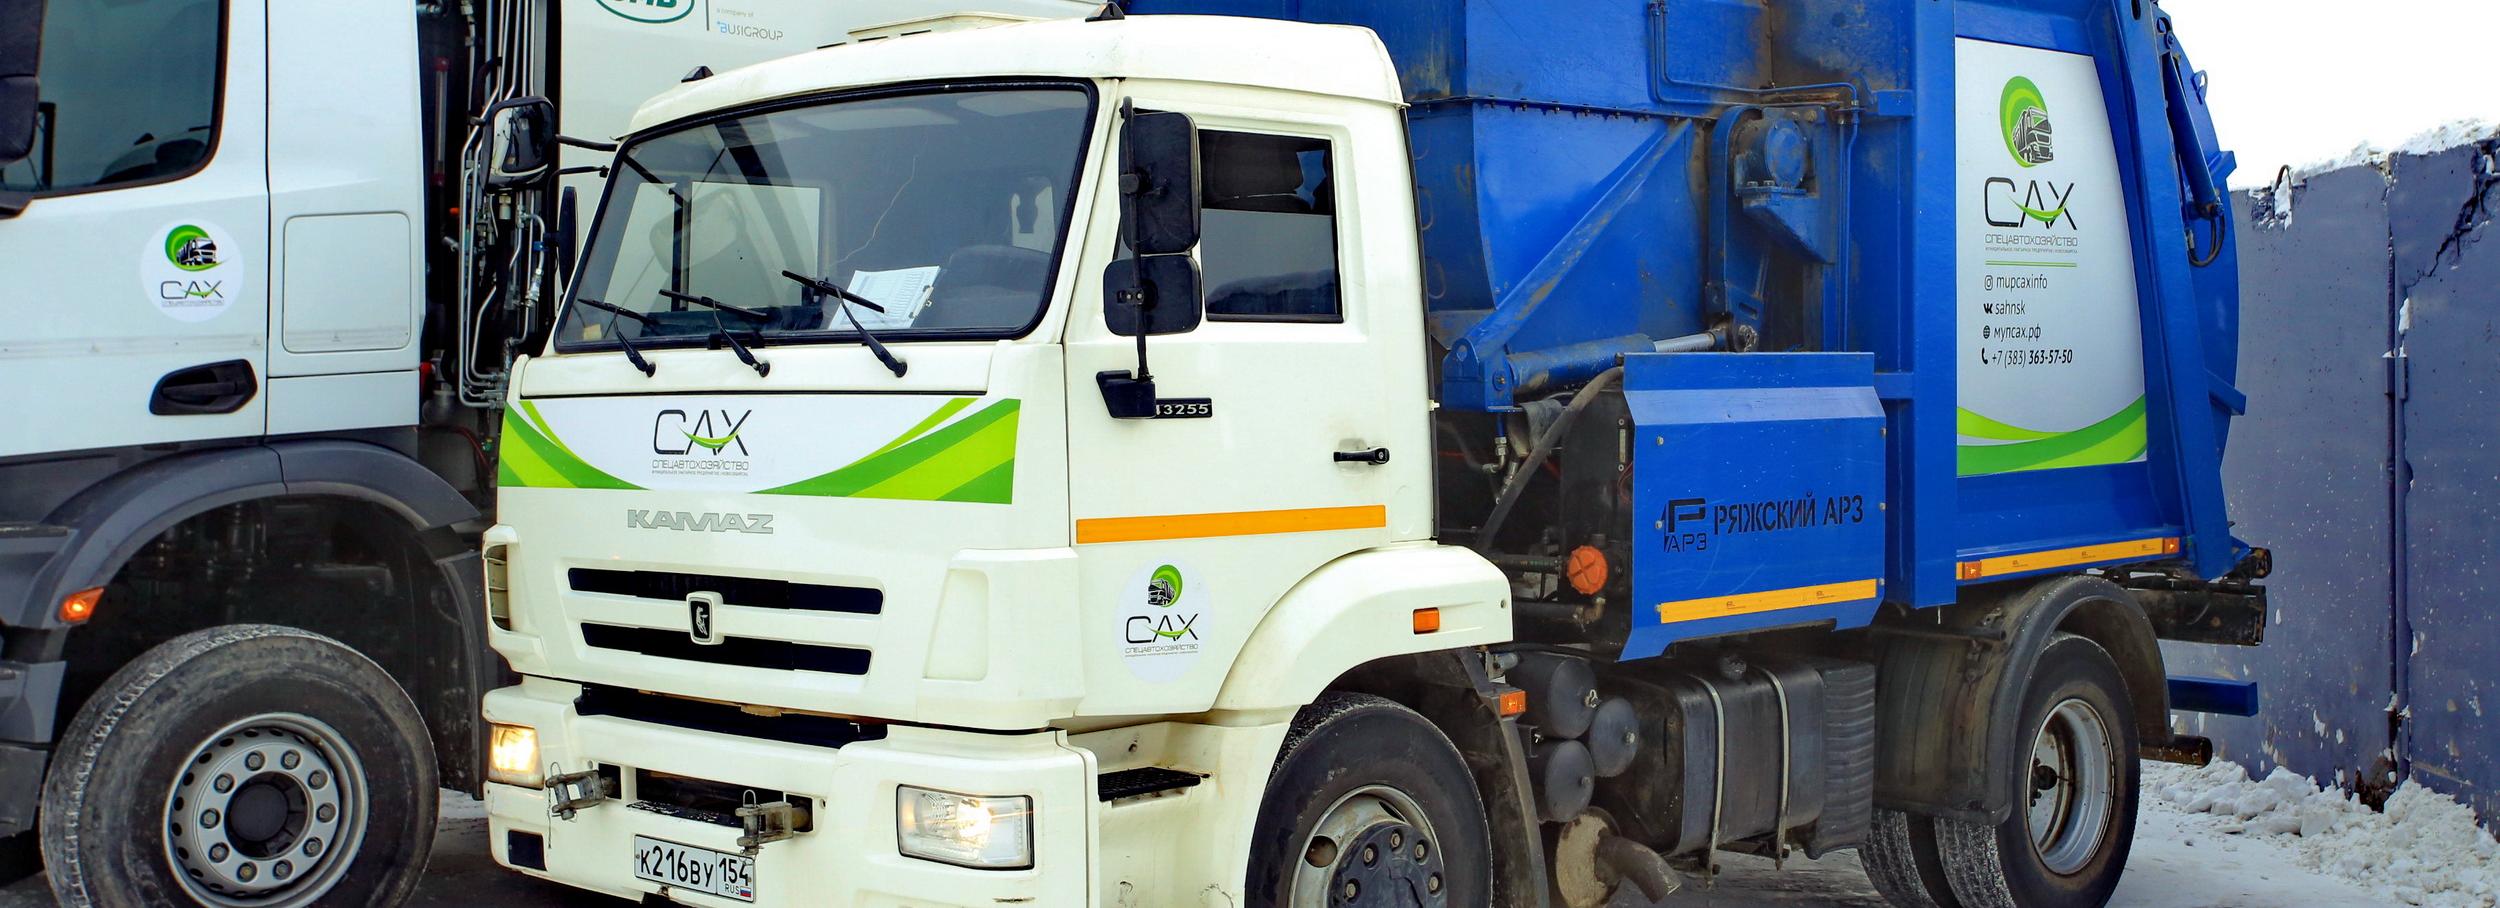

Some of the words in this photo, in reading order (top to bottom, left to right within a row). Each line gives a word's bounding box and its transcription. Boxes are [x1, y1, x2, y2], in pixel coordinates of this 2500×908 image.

[1984, 176, 2077, 230] САХ
[1985, 233, 2078, 247] СПЕЦАВТОХОЗЯЙСТВО
[1996, 273, 2048, 292] mupcaxinfo
[1995, 300, 2026, 315] sahnsk
[1993, 323, 2041, 342] мупсах.рф
[1992, 350, 2003, 365] +7
[2004, 350, 2026, 368] (383)
[2028, 349, 2073, 364] 363-57-50
[653, 409, 752, 456] САХ
[627, 509, 774, 535] KAMAZ
[1714, 491, 1816, 535] РЯЖСКИЙ
[1823, 495, 1864, 525] АРЗ
[1126, 613, 1198, 643] САХ
[718, 857, 749, 887] 154
[724, 883, 740, 895] RUS
